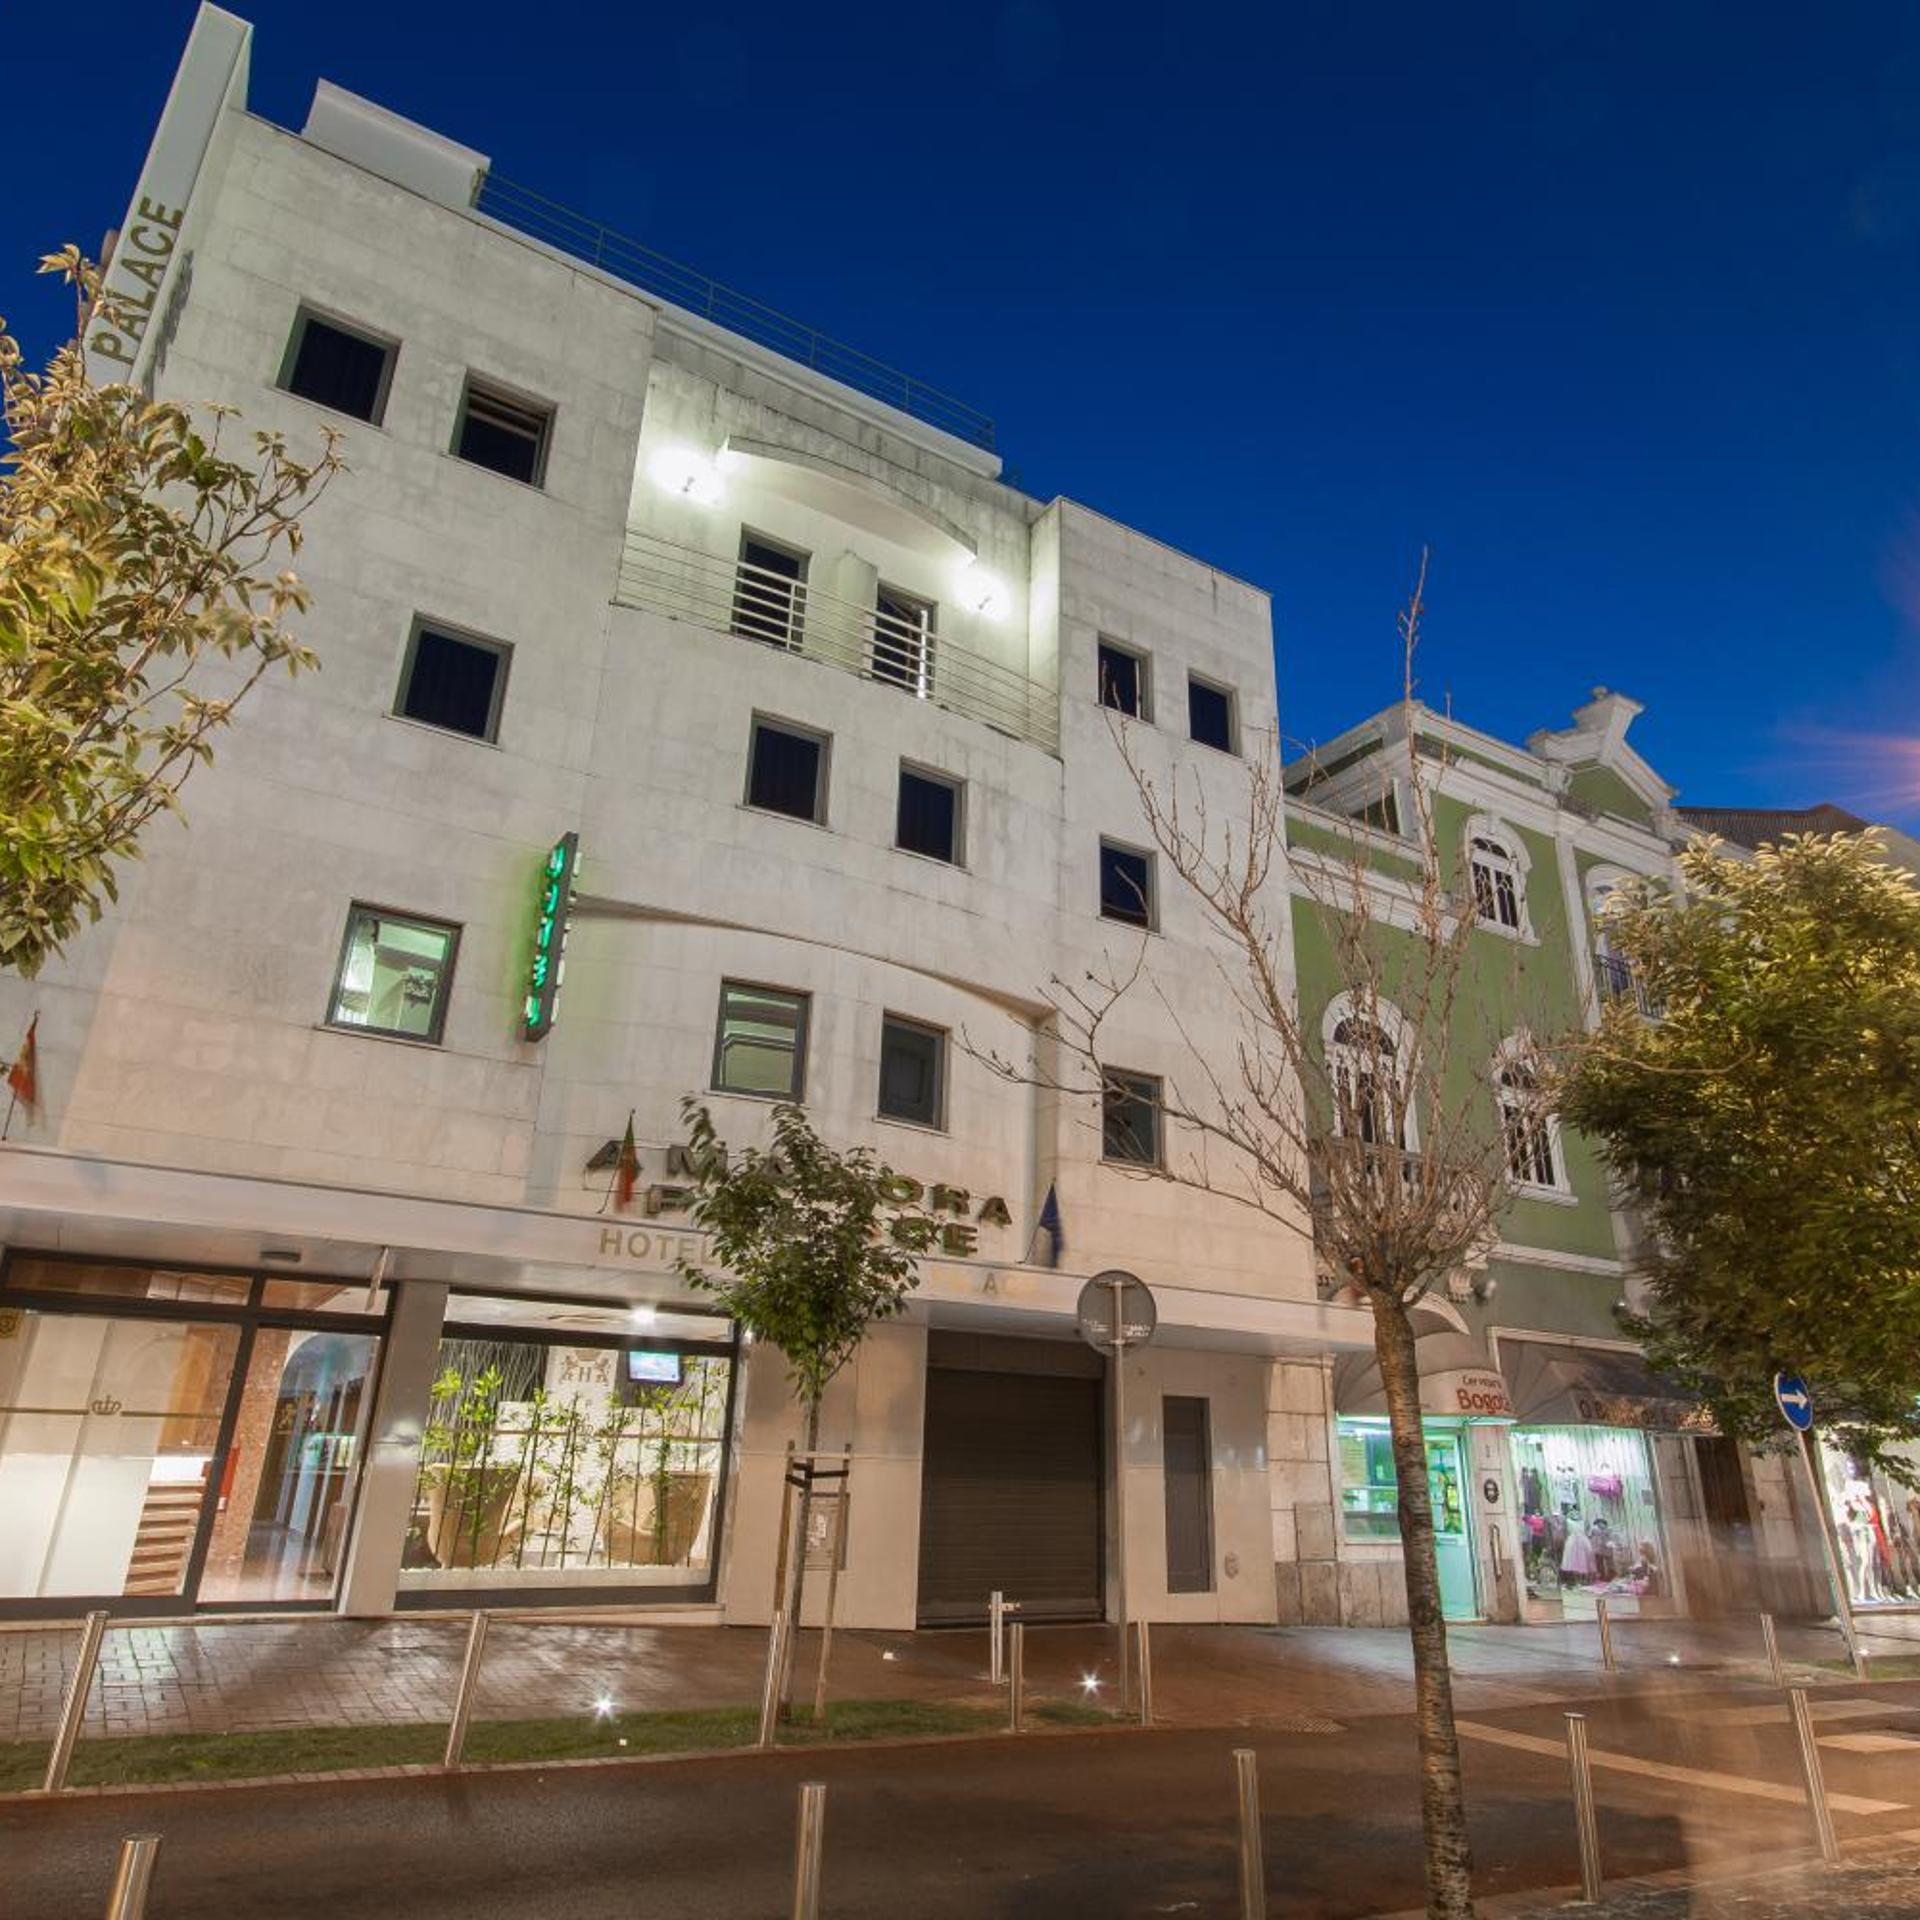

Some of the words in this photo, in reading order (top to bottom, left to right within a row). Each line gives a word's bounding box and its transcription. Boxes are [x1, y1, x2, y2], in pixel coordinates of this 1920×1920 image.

[90, 196, 184, 366] PALACE
[584, 1138, 1013, 1229] AMAORA
[598, 1228, 717, 1266] HOTEL
